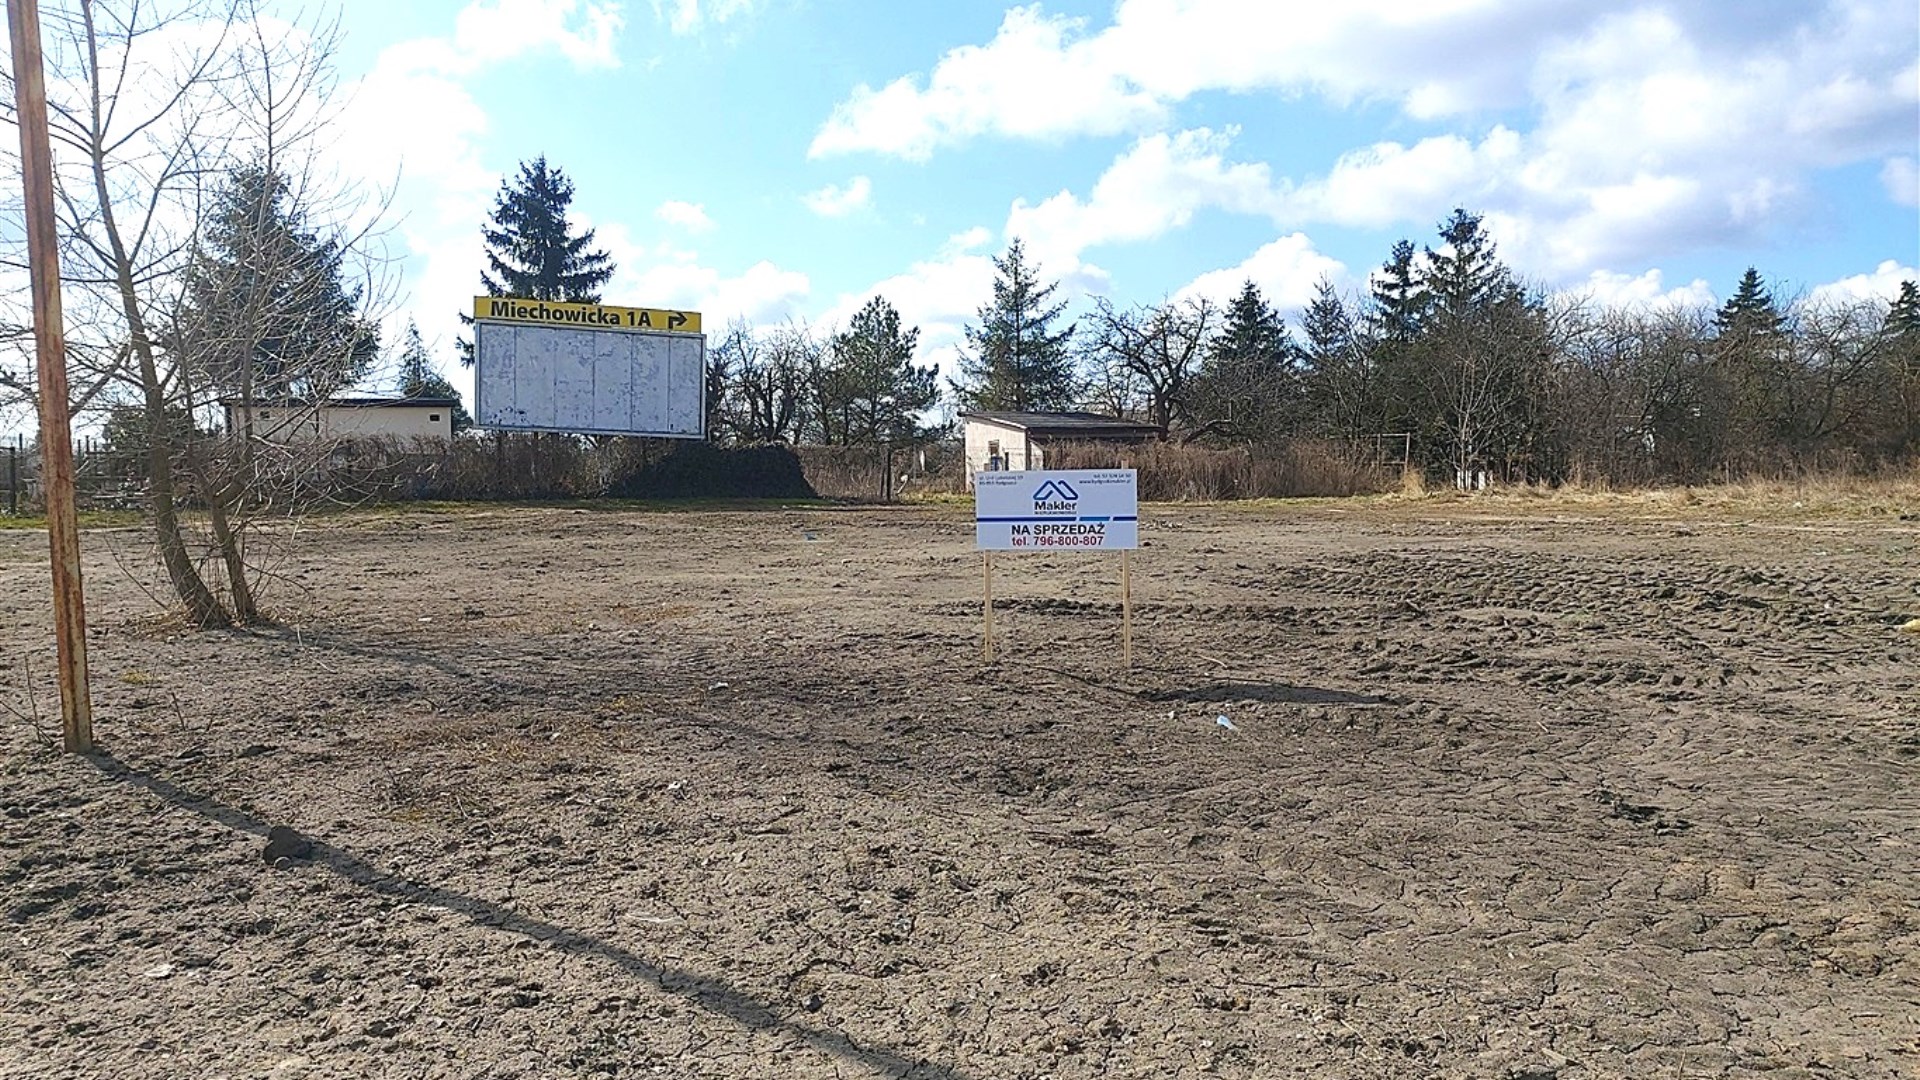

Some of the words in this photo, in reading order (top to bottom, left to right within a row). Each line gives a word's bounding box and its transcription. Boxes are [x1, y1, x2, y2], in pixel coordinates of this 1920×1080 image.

[490, 301, 621, 325] Miechowicka
[627, 311, 652, 327] 1A
[1034, 500, 1077, 511] Makler
[1011, 524, 1031, 535] NA
[1033, 521, 1106, 535] SPRZEDAŻ
[1011, 536, 1030, 546] tel.
[1033, 536, 1104, 546] 796-800-807
